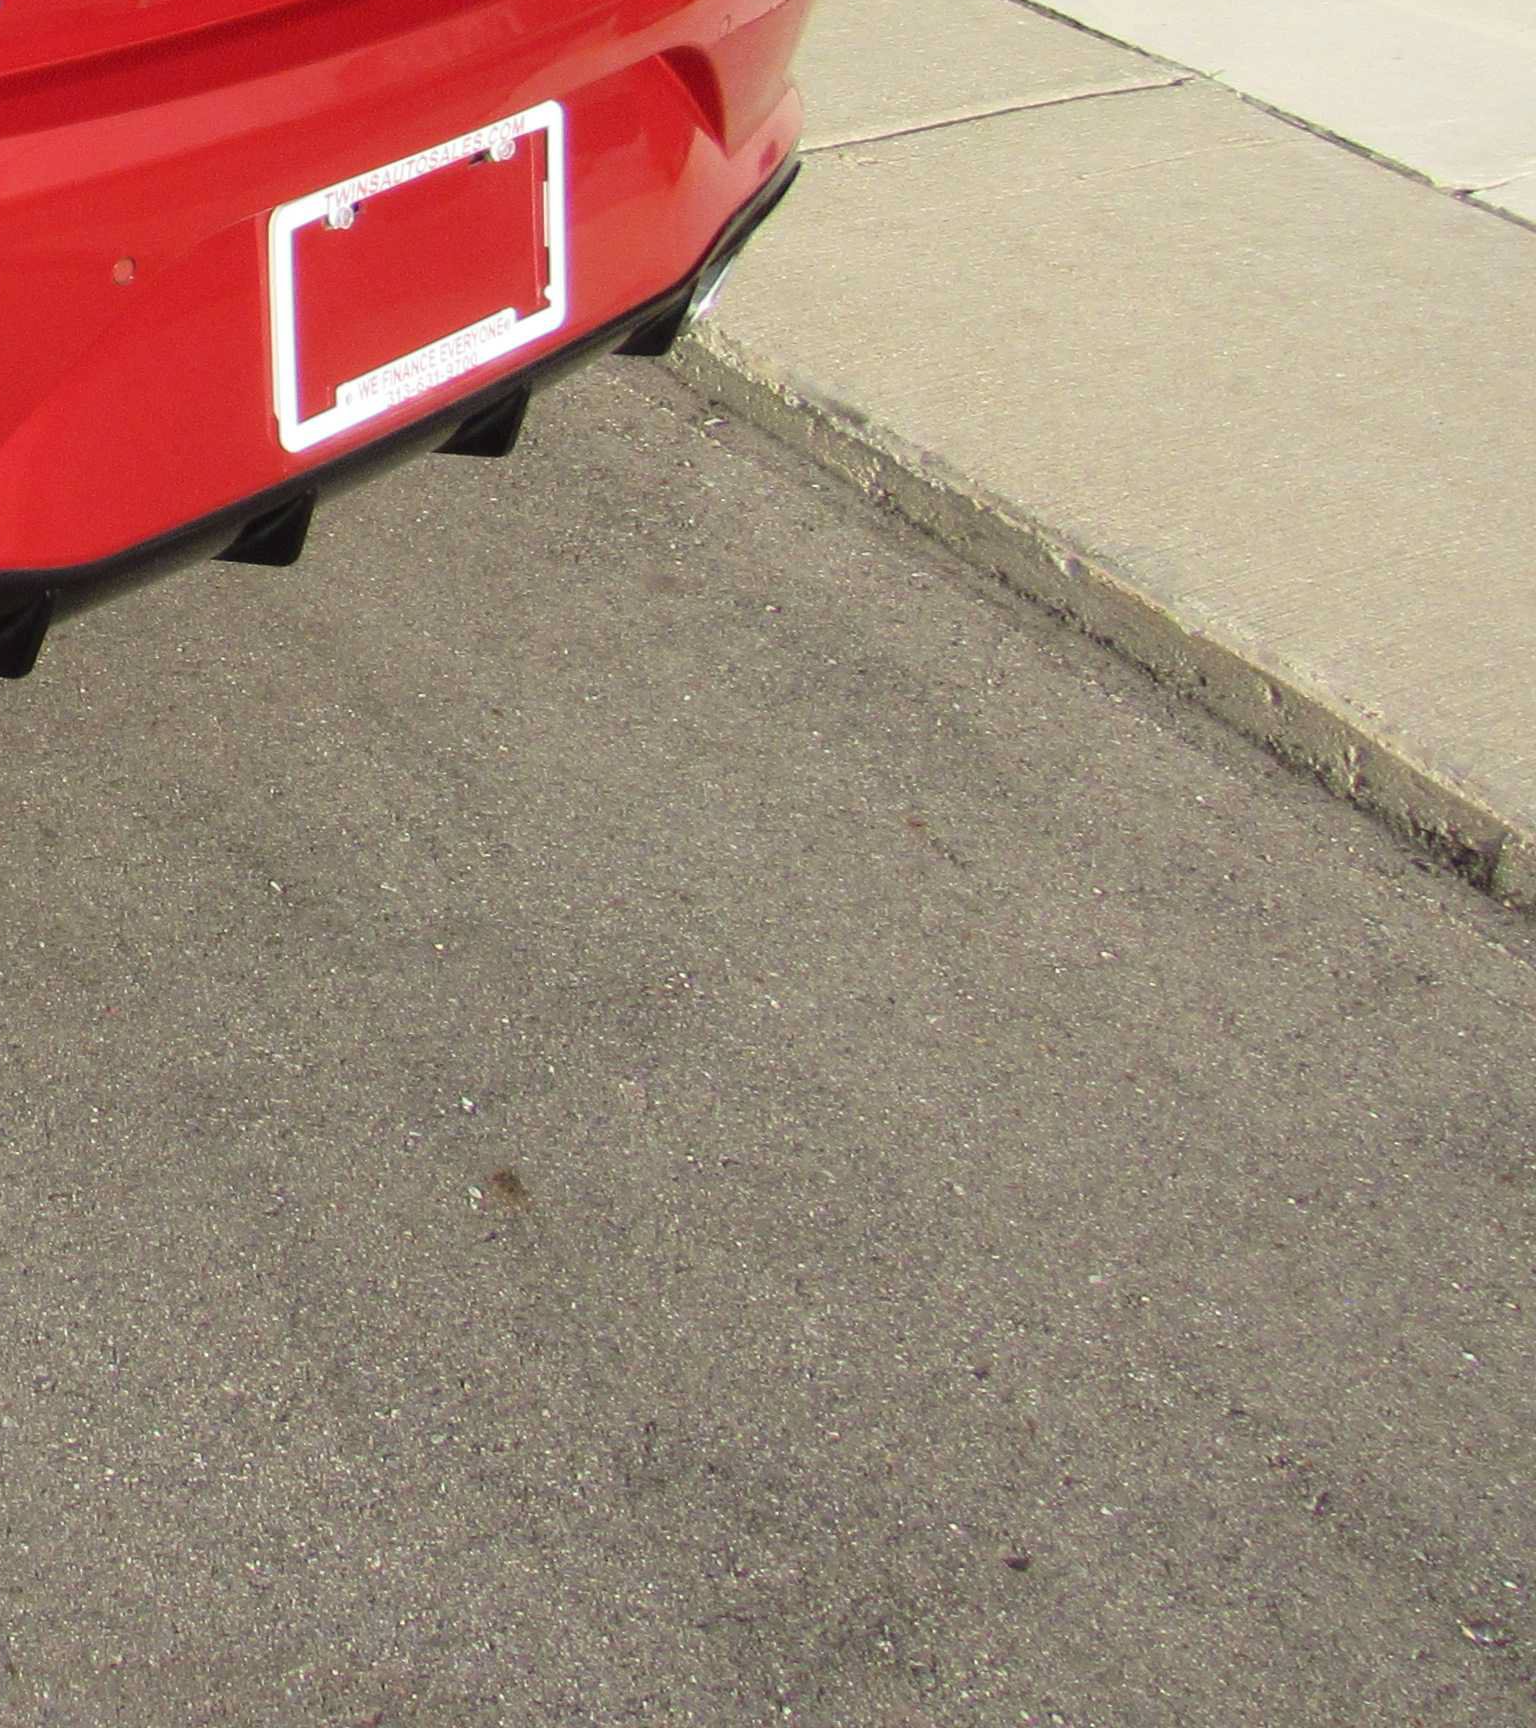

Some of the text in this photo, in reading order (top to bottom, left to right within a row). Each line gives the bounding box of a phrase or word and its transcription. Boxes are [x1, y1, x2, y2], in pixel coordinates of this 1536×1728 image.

[324, 115, 526, 209] TWINSAUTOSALES.COM
[358, 317, 505, 400] WE FINANCE EVERYONE
